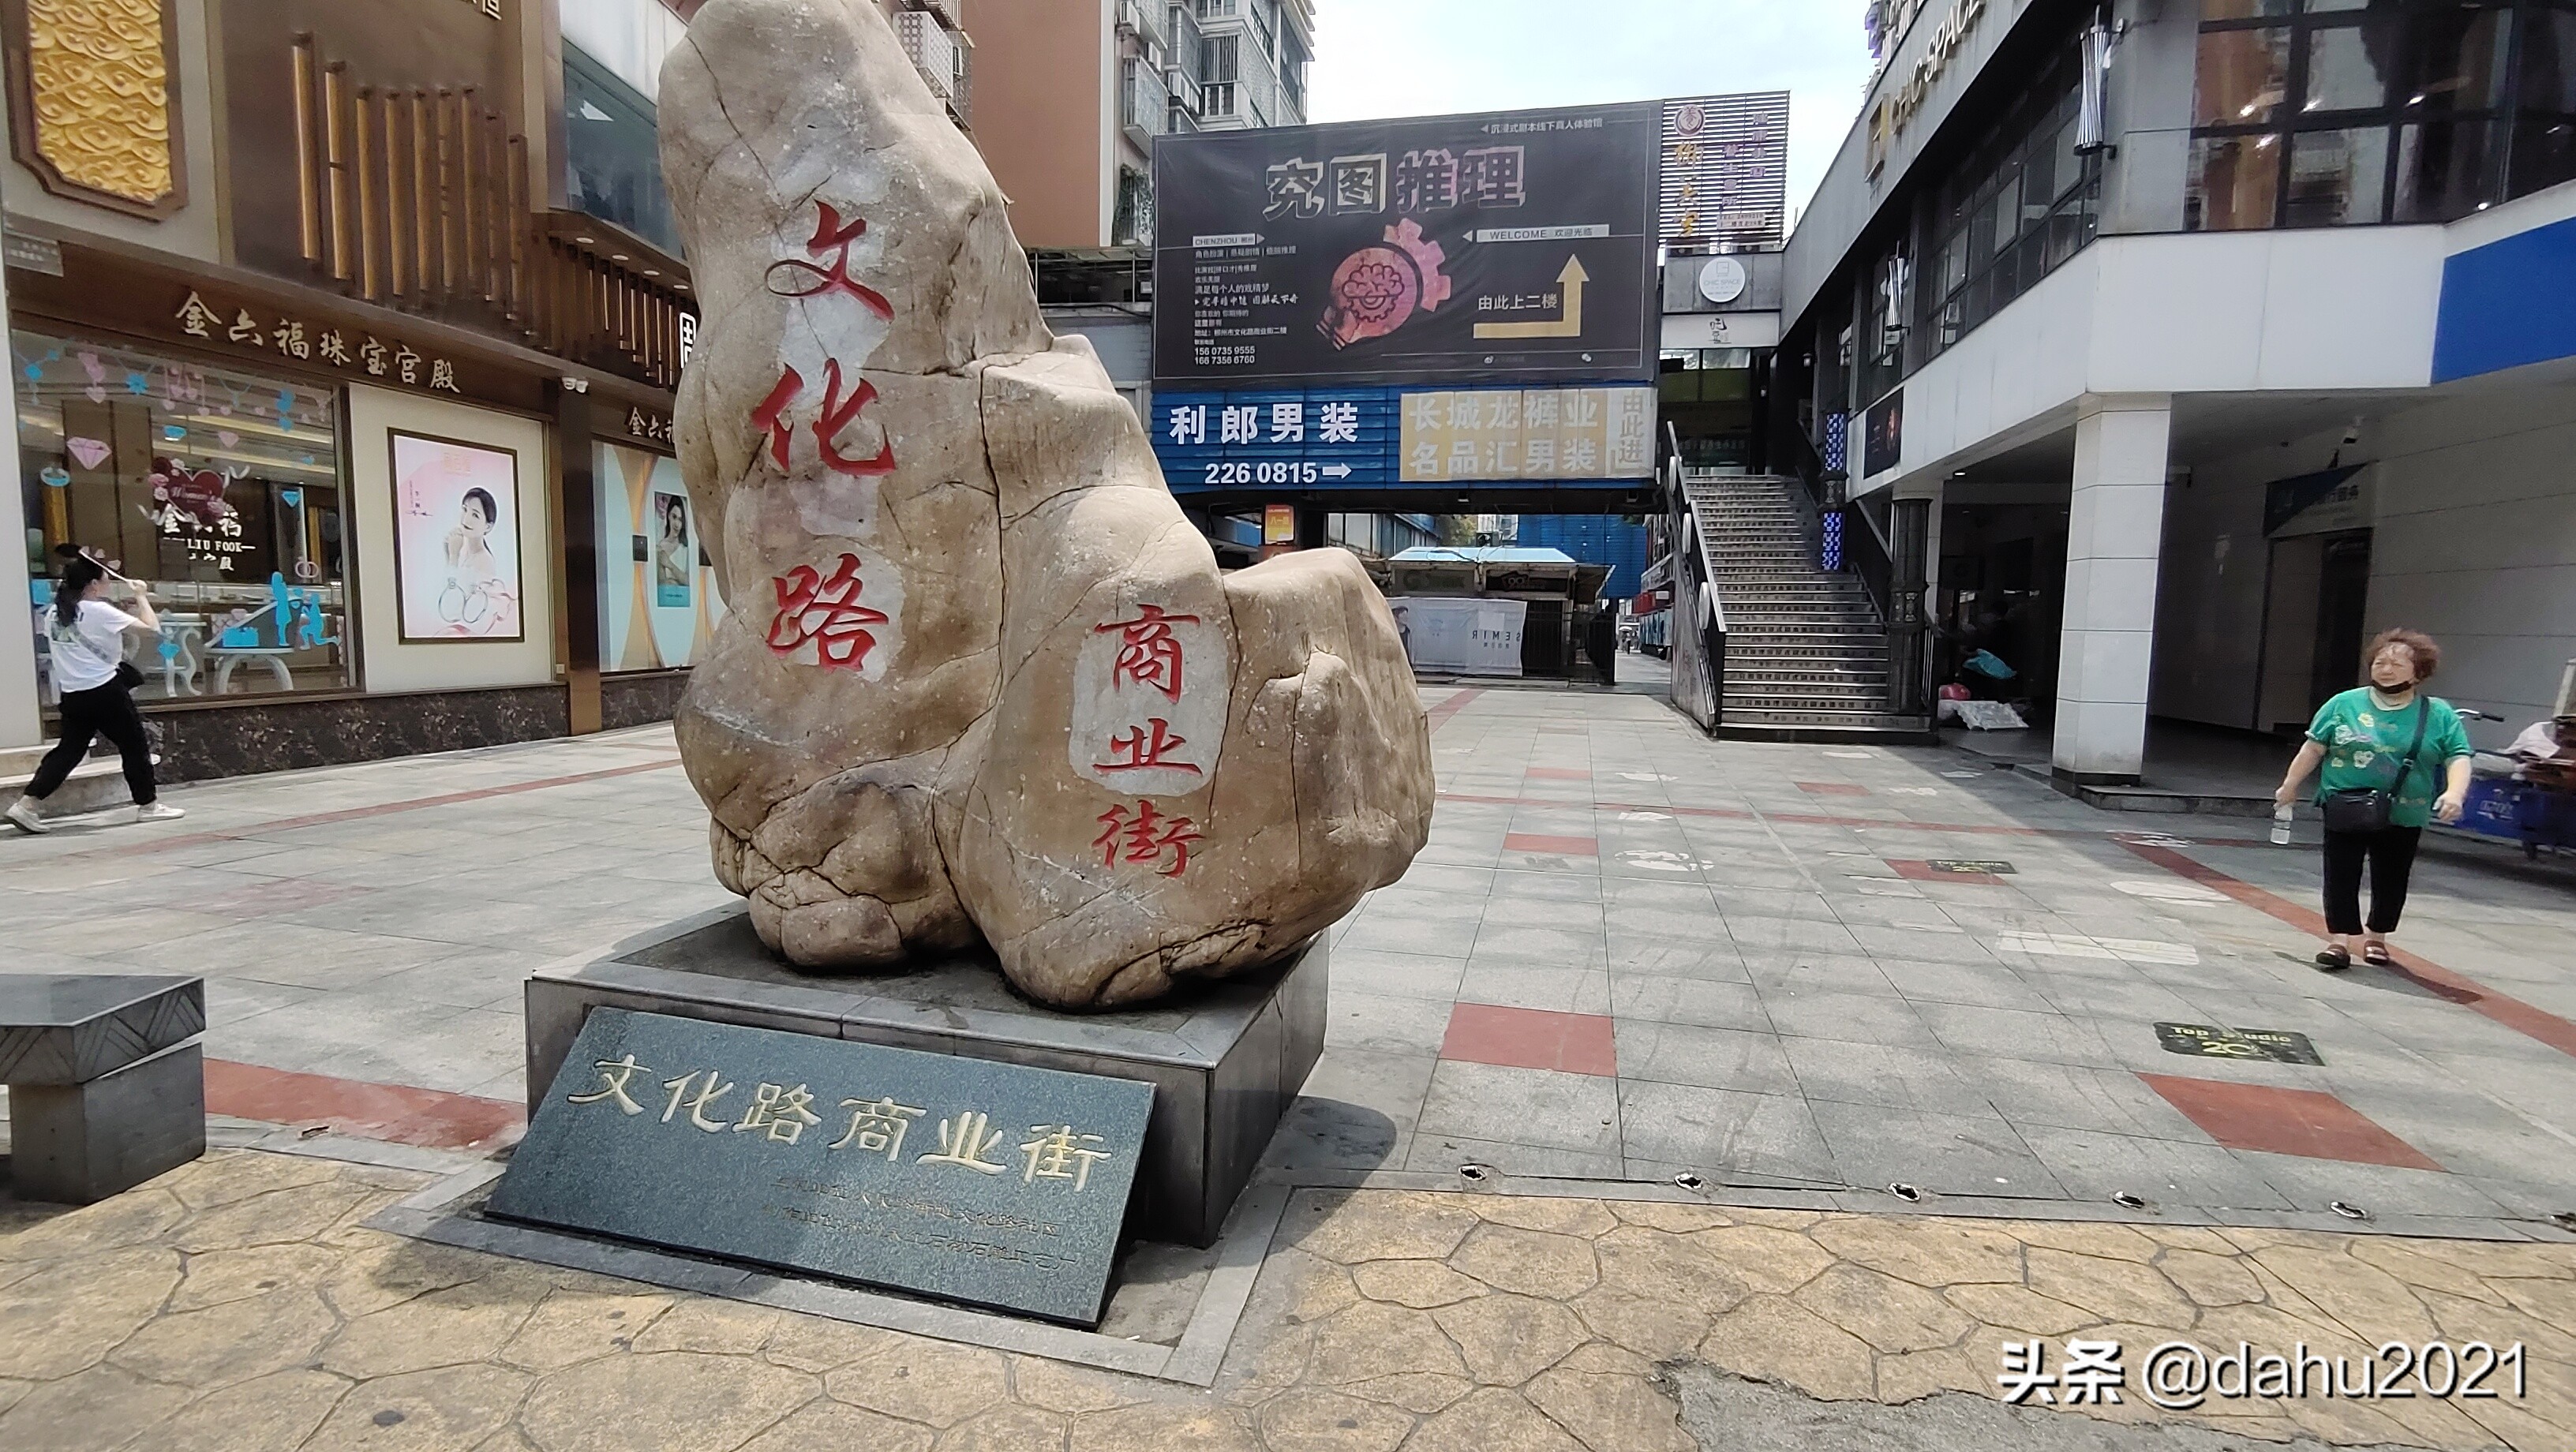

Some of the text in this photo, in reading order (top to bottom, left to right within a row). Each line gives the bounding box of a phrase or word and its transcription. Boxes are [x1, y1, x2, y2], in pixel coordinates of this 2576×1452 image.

[1263, 144, 1527, 222] 究图推理
[1489, 227, 1593, 240] WELCOME 欢迎光临
[1478, 293, 1558, 310] 由此上二楼
[175, 290, 461, 394] 金六福珠宝宫殿
[1195, 346, 1256, 356] 156 0735 9555
[628, 406, 673, 444] 金六
[752, 199, 896, 674] 文化路
[1169, 402, 1359, 445] 利郎男装
[1619, 390, 1645, 467] 由此进
[1204, 462, 1318, 485] 226 0815
[1408, 437, 1597, 475] 名品汇男装
[187, 538, 243, 552] LIU FOOK
[1093, 604, 1206, 879] 商业街
[2171, 1027, 2210, 1037] Top
[567, 1053, 1113, 1192] 文化路商业街
